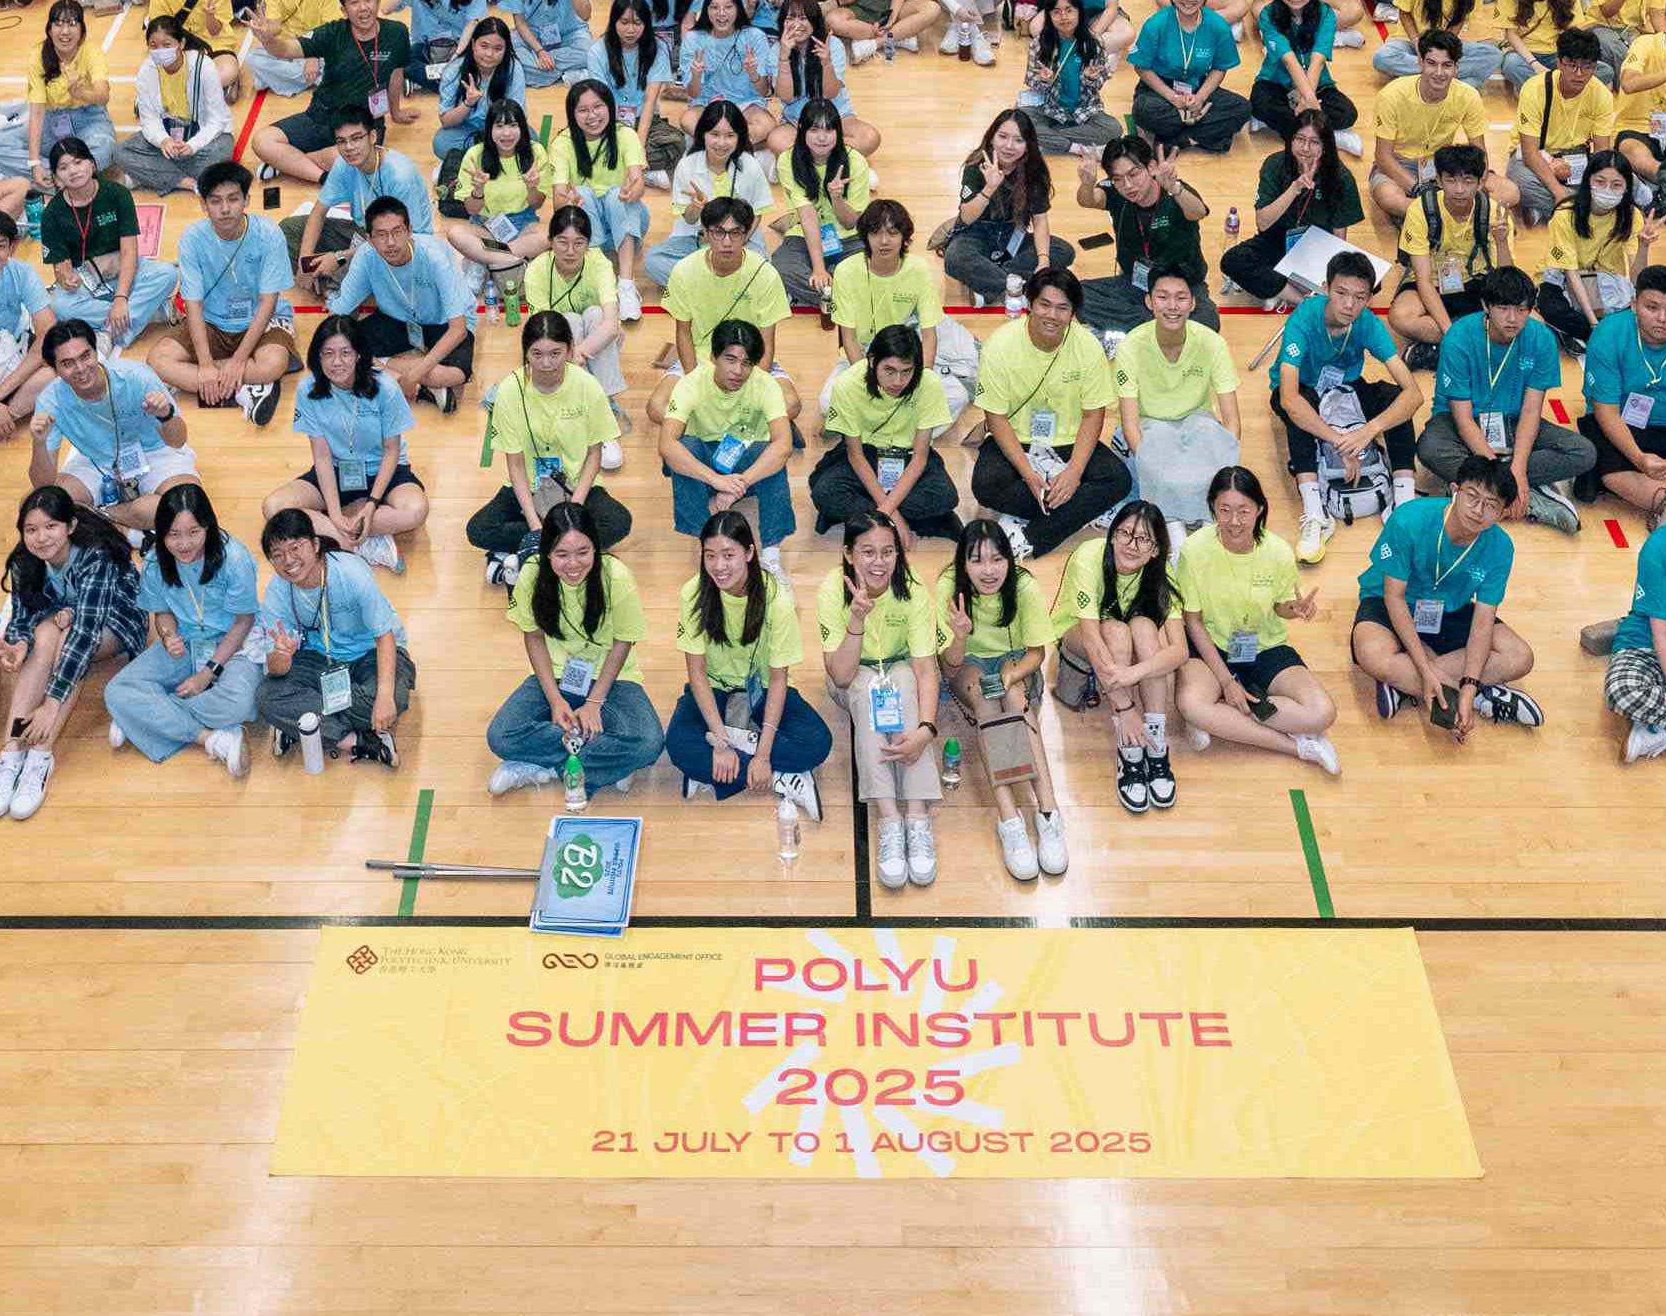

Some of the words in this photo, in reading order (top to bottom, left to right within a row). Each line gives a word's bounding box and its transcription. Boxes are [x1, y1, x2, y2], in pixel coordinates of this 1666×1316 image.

[560, 842, 598, 889] B2
[438, 946, 468, 956] KONG
[452, 957, 512, 966] UNIVERSITY
[604, 952, 637, 961] GLOBAL
[637, 952, 693, 961] ENGAGEMENT
[694, 953, 724, 961] OFFICE
[754, 957, 979, 993] POLYU
[505, 1010, 828, 1048] SUMMER
[855, 1011, 1233, 1048] INSTITUTE
[775, 1067, 966, 1105] 2025
[590, 1130, 636, 1154] 21
[653, 1130, 750, 1154] JULY
[768, 1130, 820, 1154] TO
[836, 1130, 854, 1154] 1
[871, 1130, 1033, 1154] AUGUST
[1050, 1130, 1152, 1154] 2025
